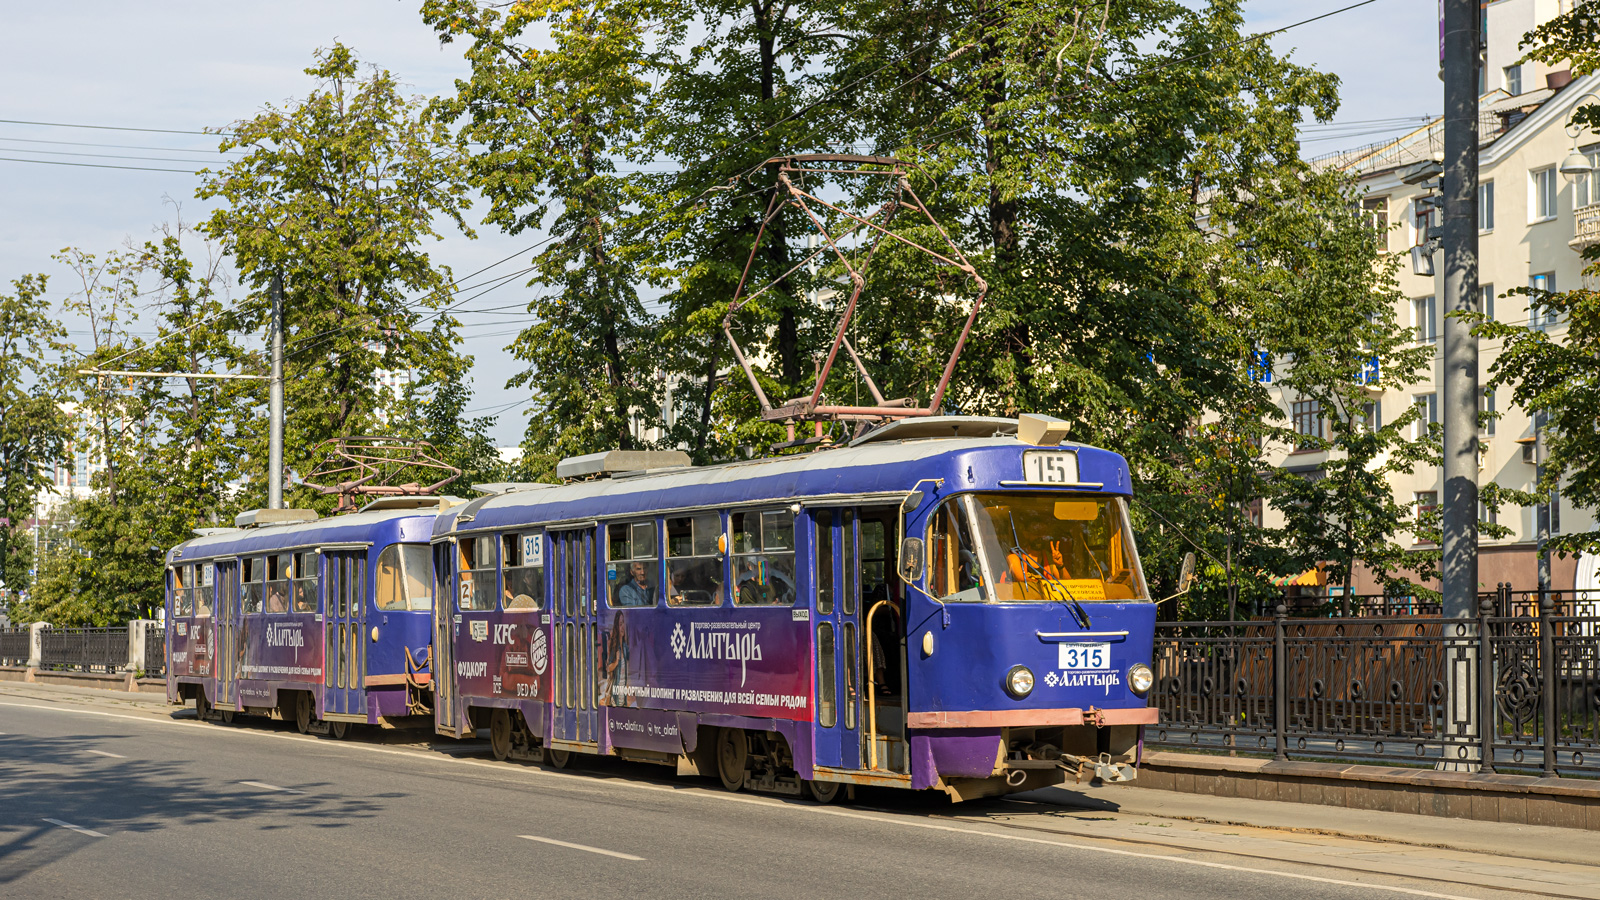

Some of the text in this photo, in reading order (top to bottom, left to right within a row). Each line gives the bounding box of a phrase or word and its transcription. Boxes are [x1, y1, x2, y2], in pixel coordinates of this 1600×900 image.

[1033, 456, 1066, 483] 15
[525, 536, 540, 556] 315
[461, 584, 469, 599] 2
[793, 610, 808, 619] ВЫХОД
[493, 623, 517, 645] KFC
[694, 621, 761, 631] торгово-развлекательный центр
[532, 643, 547, 663] KING
[685, 622, 763, 688] Алатырь
[1067, 649, 1103, 667] 315
[457, 661, 487, 679] ФУДКОРТ
[1059, 671, 1120, 696] Алатырь
[612, 684, 807, 709] КОМФОРТНЫЙ ШОПИНГ И РАЗВЛЕЧЕНИЯ ДЛЯ ВСЕЙ СЕМЬИ РЯДОМ
